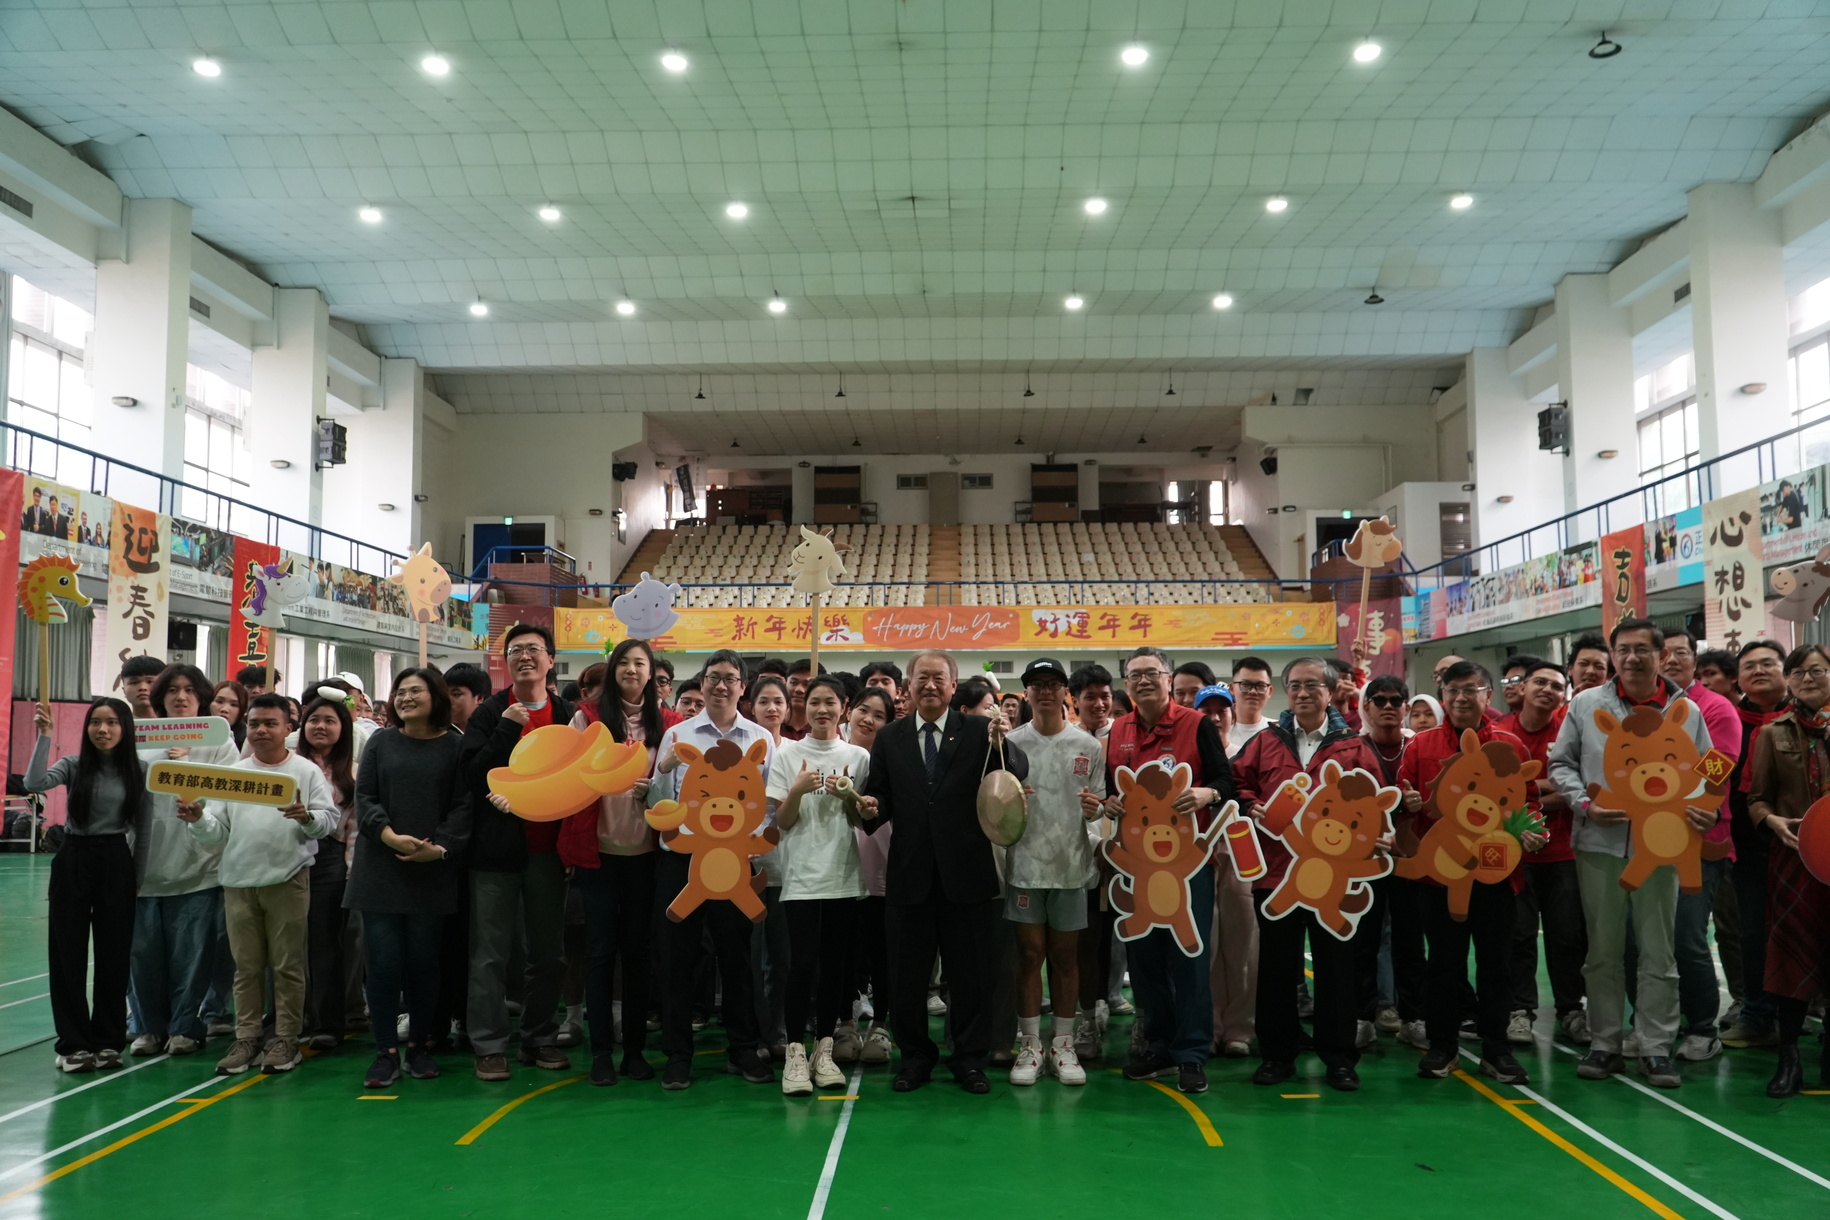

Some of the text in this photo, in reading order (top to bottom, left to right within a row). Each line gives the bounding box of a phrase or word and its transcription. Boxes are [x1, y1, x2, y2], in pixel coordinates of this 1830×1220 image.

[731, 613, 850, 642] 新年快樂
[872, 612, 1011, 642] Happy New Year
[1034, 611, 1152, 640] 好運年年
[148, 734, 171, 742] KEEP
[162, 722, 210, 731] LEARNING
[1705, 757, 1724, 776] 財
[157, 771, 284, 798] 教育部高教深耕計畫
[1484, 847, 1502, 866] 旺
